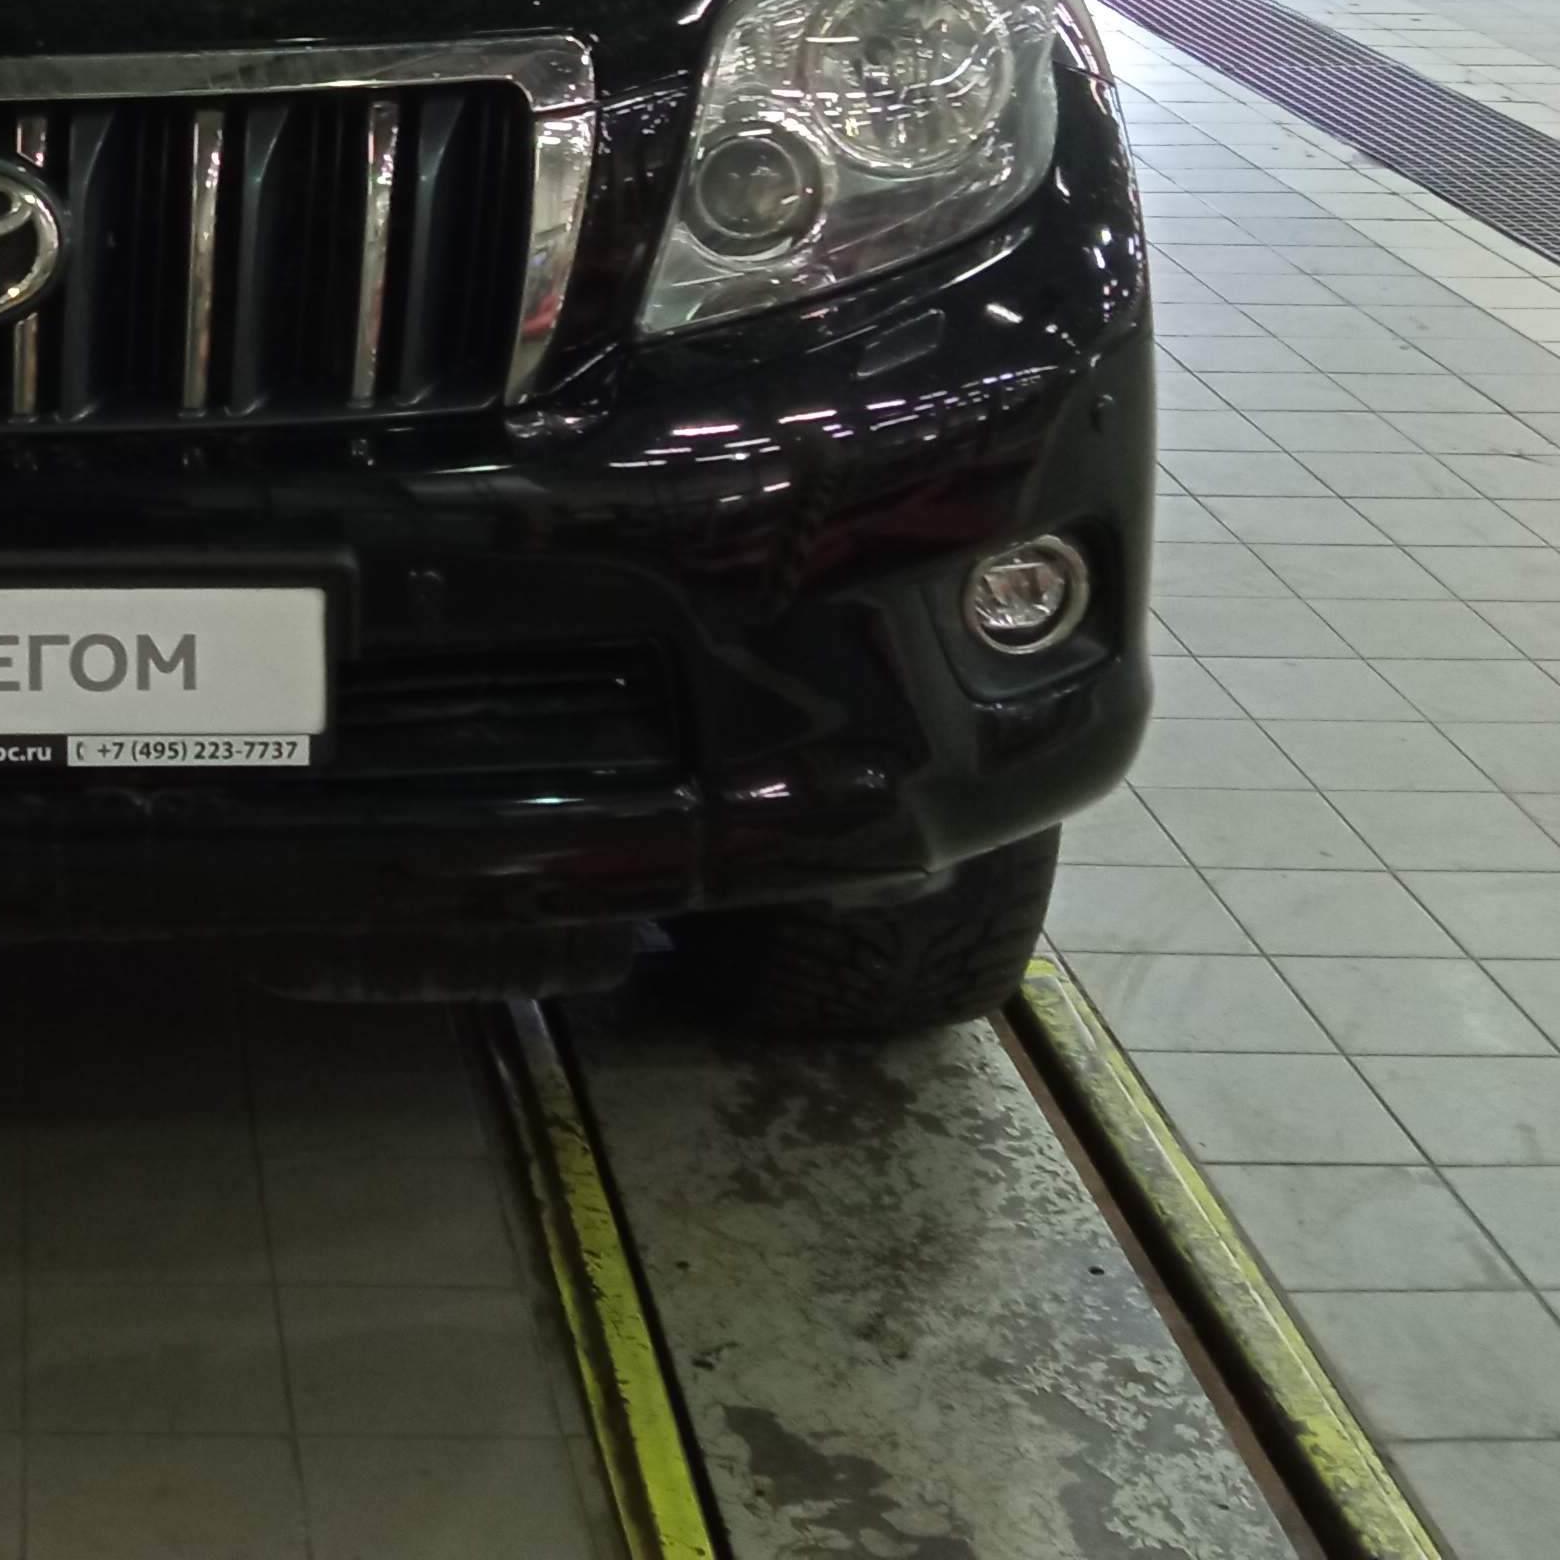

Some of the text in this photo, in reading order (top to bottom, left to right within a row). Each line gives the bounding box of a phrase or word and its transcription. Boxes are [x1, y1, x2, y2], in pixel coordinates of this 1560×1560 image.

[97, 740, 298, 762] +7 (495) 223-7737
